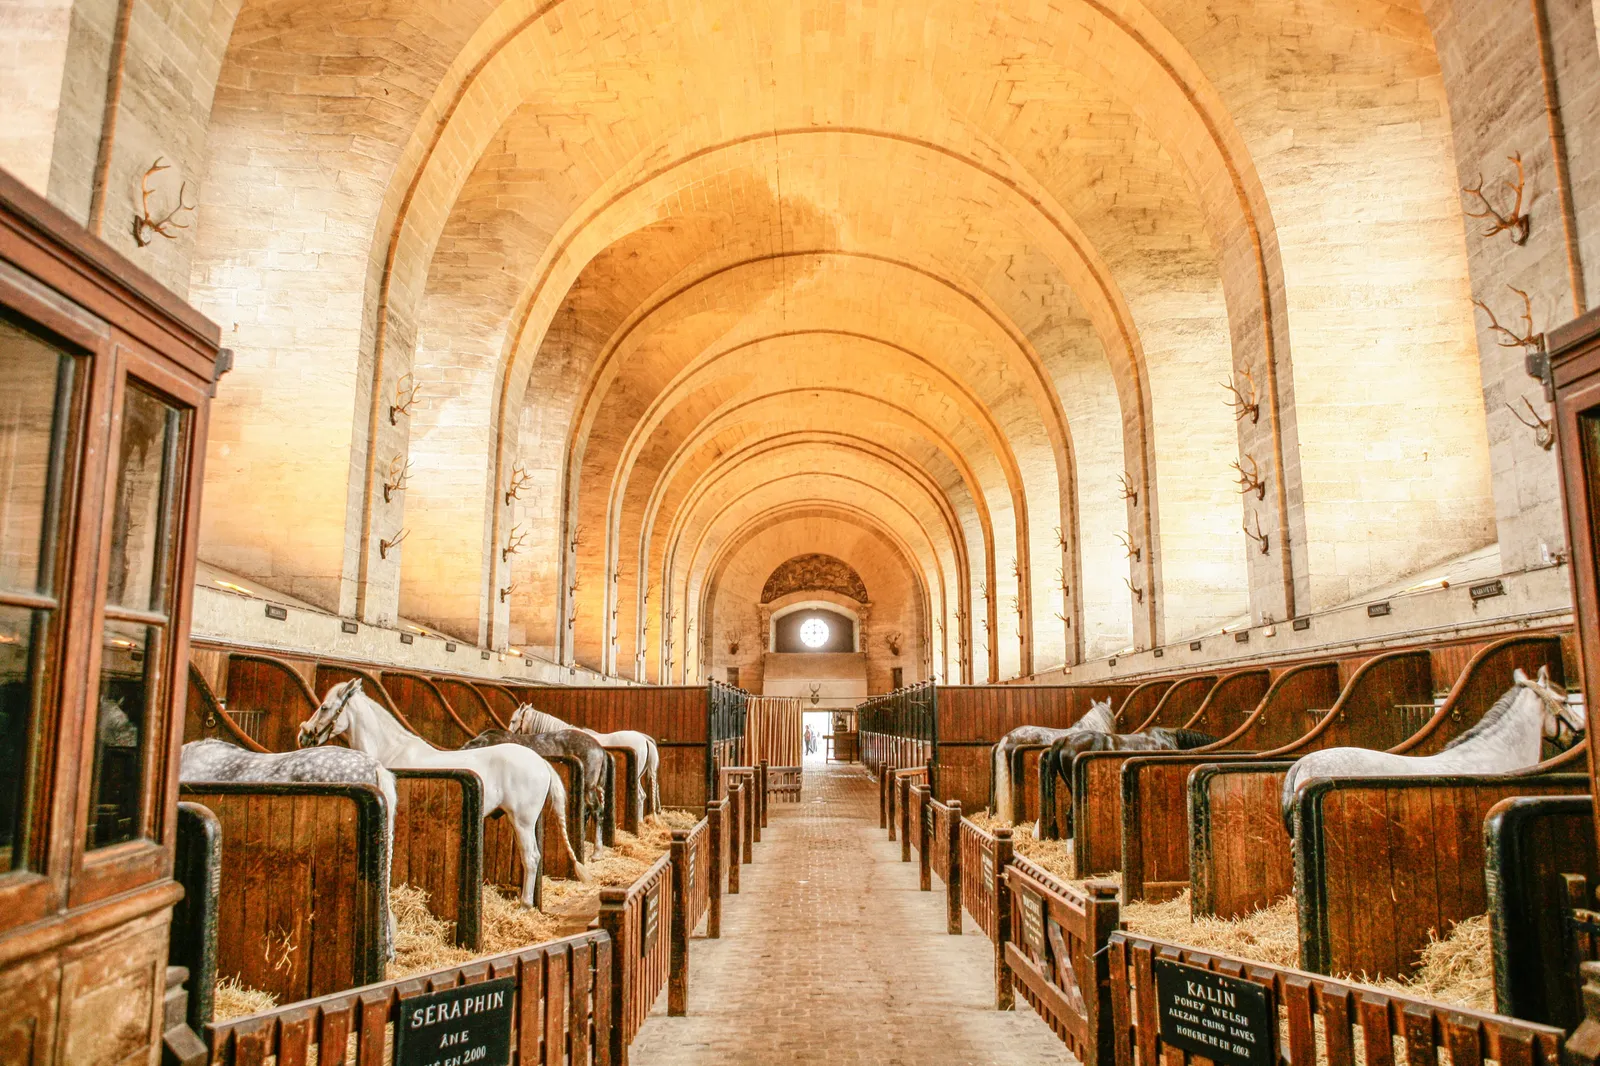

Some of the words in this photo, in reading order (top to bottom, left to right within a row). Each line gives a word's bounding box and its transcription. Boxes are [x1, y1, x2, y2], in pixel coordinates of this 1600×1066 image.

[1187, 980, 1235, 1008] KALIN
[411, 990, 505, 1028] SÉRAPHIN
[1169, 1007, 1199, 1023] ALEZAN
[1202, 1018, 1226, 1032] CRINS
[1174, 995, 1205, 1012] PONEY
[1211, 1006, 1249, 1027] WELSH
[463, 1045, 487, 1064] 2000
[1219, 1039, 1231, 1051] EN
[1232, 1043, 1250, 1058] 2002
